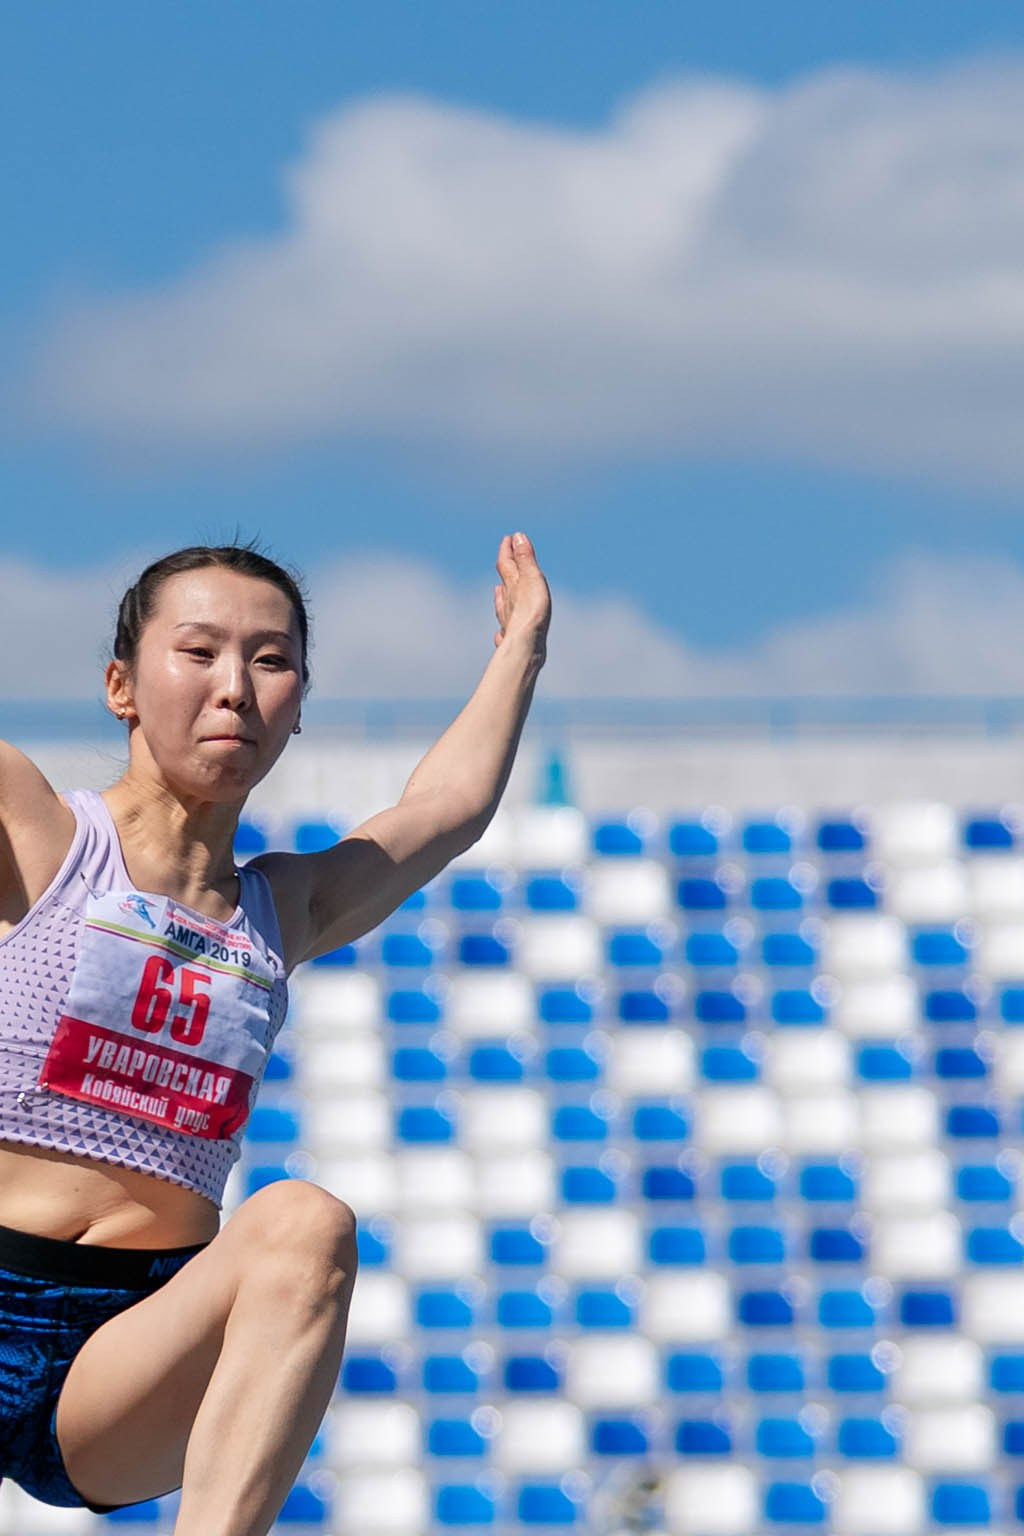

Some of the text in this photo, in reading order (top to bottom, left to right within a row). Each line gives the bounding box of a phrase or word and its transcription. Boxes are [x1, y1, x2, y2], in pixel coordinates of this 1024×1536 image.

[164, 921, 206, 955] АМГА
[210, 942, 251, 968] 2019
[130, 954, 212, 1047] 65
[80, 1073, 169, 1118] Кобяйский
[82, 1034, 232, 1106] УВАРОВСКАЯ
